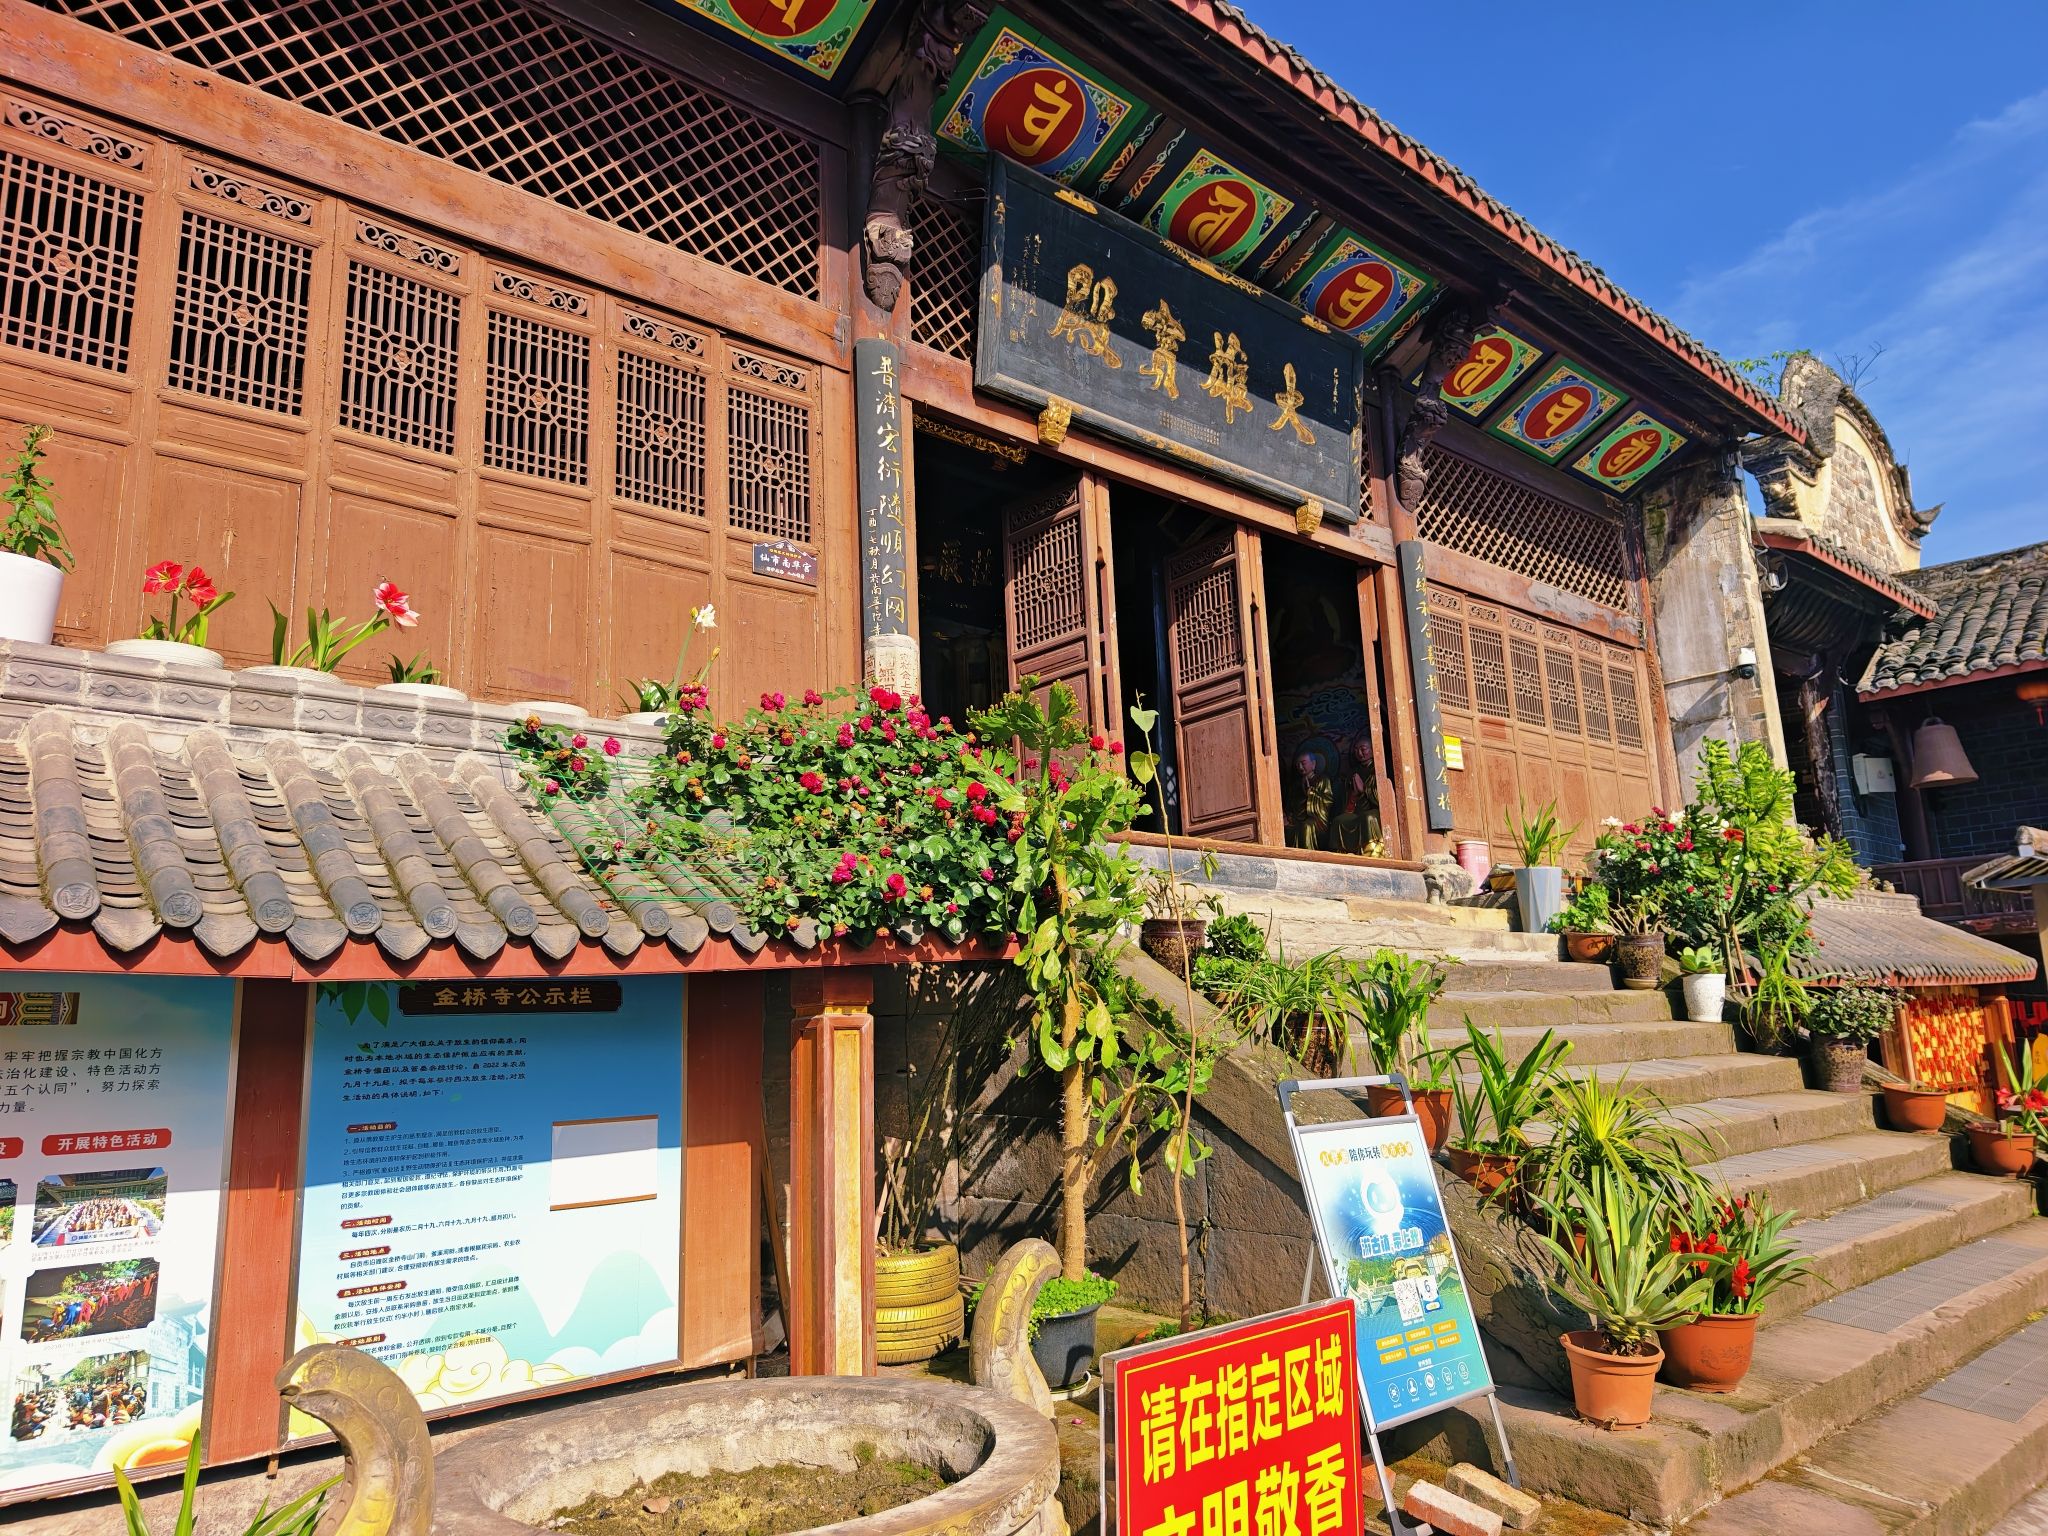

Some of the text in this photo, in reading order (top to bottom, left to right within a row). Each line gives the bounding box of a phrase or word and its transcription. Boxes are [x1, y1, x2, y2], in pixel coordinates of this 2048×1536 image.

[433, 986, 593, 1007] 金桥寺公示栏
[4, 1047, 164, 1063] 牢牢把握宗教中国化方
[57, 1132, 158, 1151] 开展特色活动
[1140, 1332, 1345, 1486] 请在指定区域
